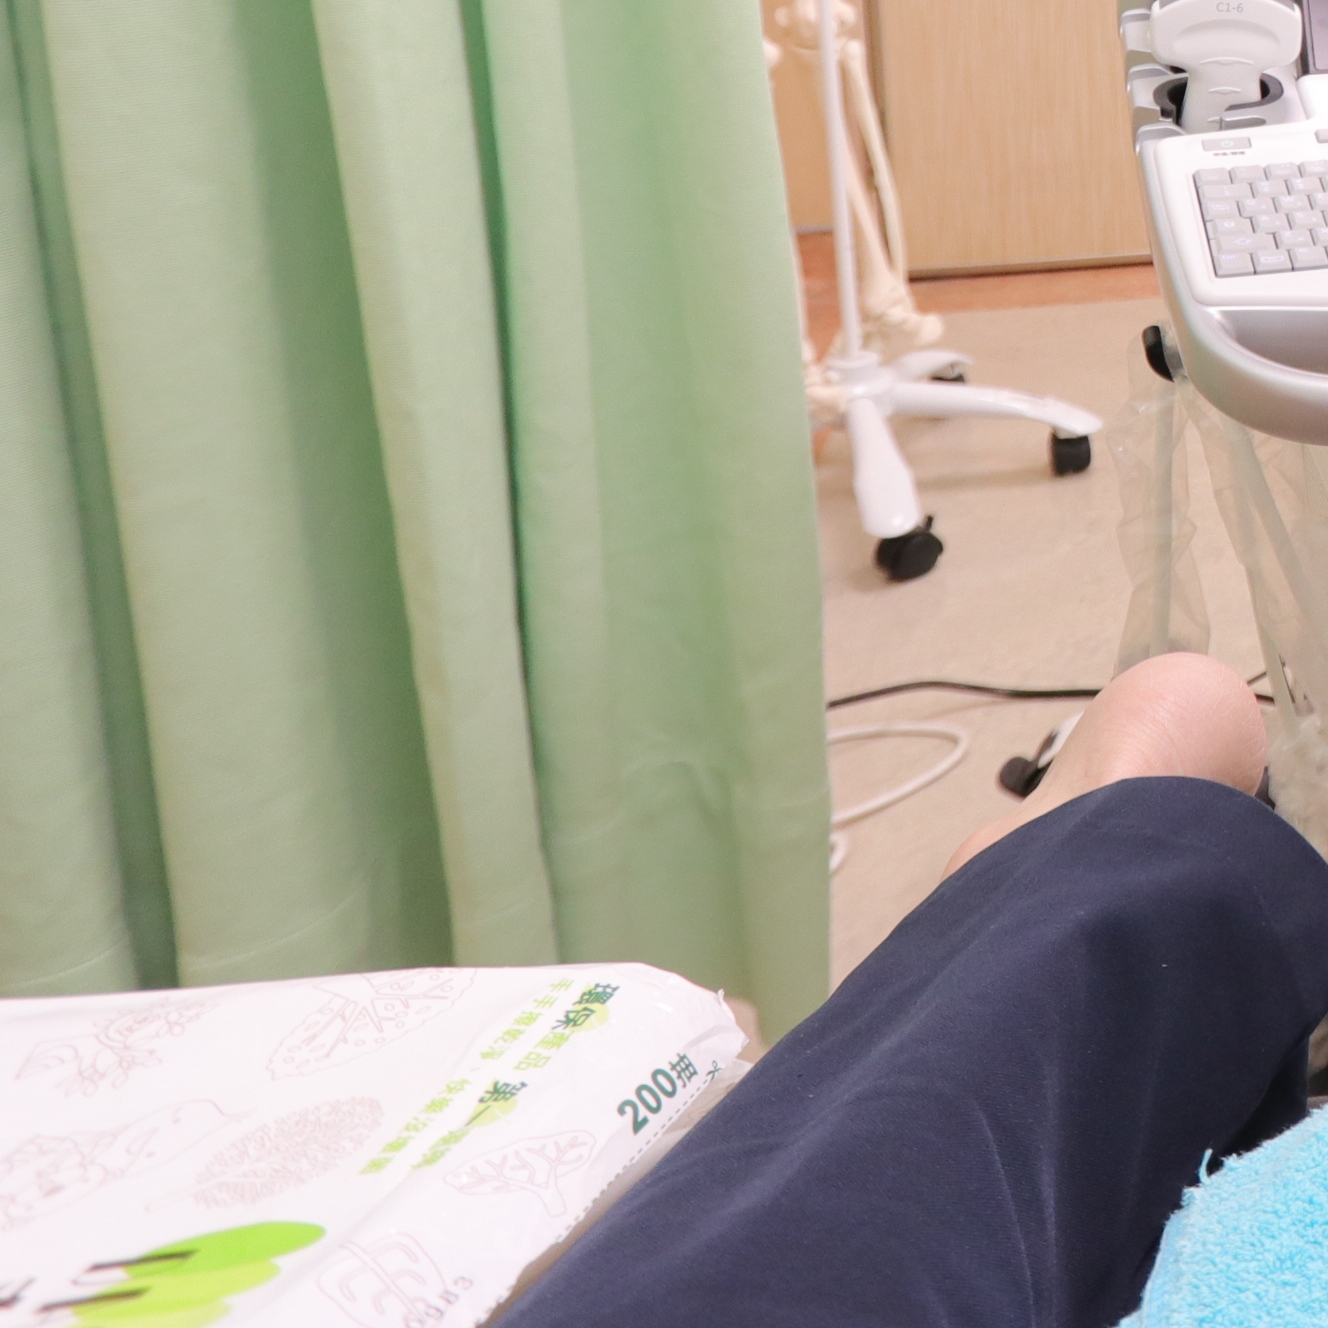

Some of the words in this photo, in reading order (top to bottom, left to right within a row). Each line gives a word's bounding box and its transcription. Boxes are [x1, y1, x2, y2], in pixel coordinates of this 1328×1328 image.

[1216, 2, 1244, 13] C1-6
[513, 982, 620, 1071] 環保產品
[617, 1052, 699, 1135] 200抽
